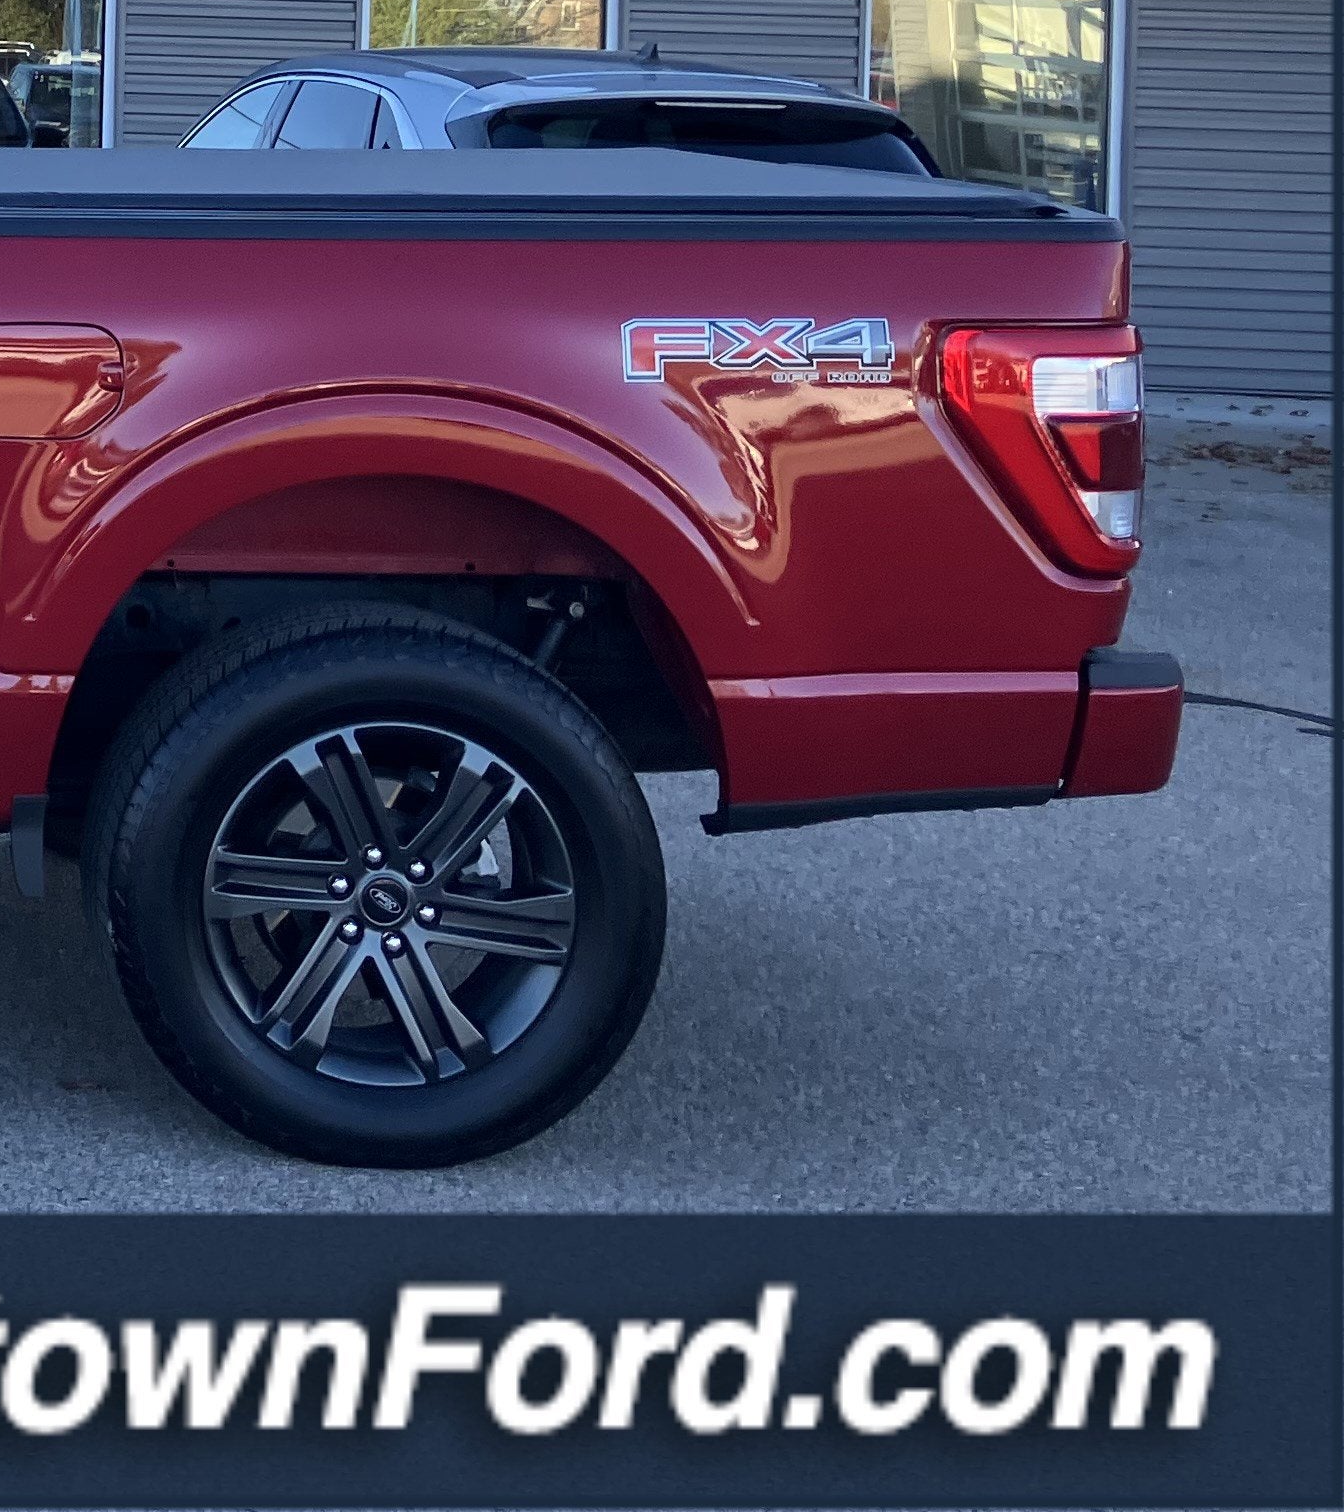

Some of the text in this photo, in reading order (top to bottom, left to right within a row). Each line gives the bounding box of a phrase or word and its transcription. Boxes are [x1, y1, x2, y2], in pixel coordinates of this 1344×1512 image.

[621, 317, 895, 382] FX4
[771, 371, 893, 384] OFF ROAD
